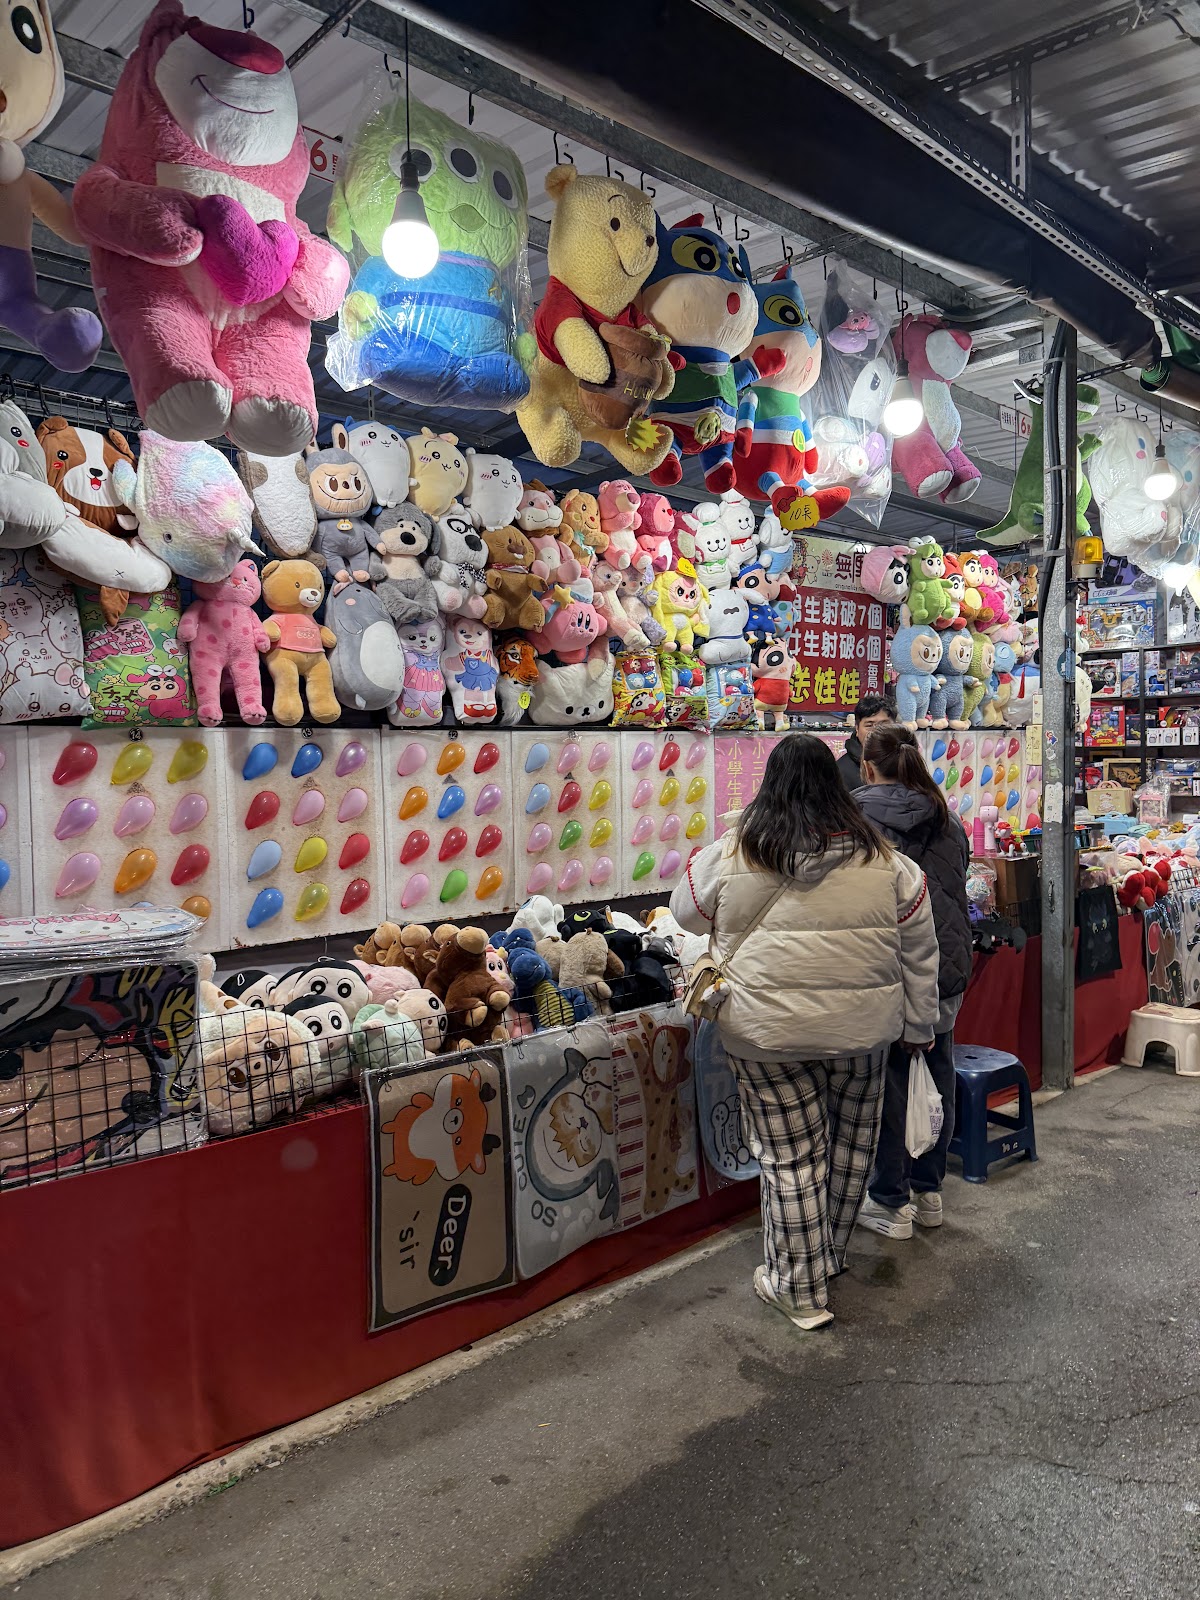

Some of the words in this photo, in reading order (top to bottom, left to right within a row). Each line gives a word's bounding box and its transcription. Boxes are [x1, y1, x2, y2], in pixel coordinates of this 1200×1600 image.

[790, 666, 861, 705] 送娃娃
[664, 732, 674, 742] 10
